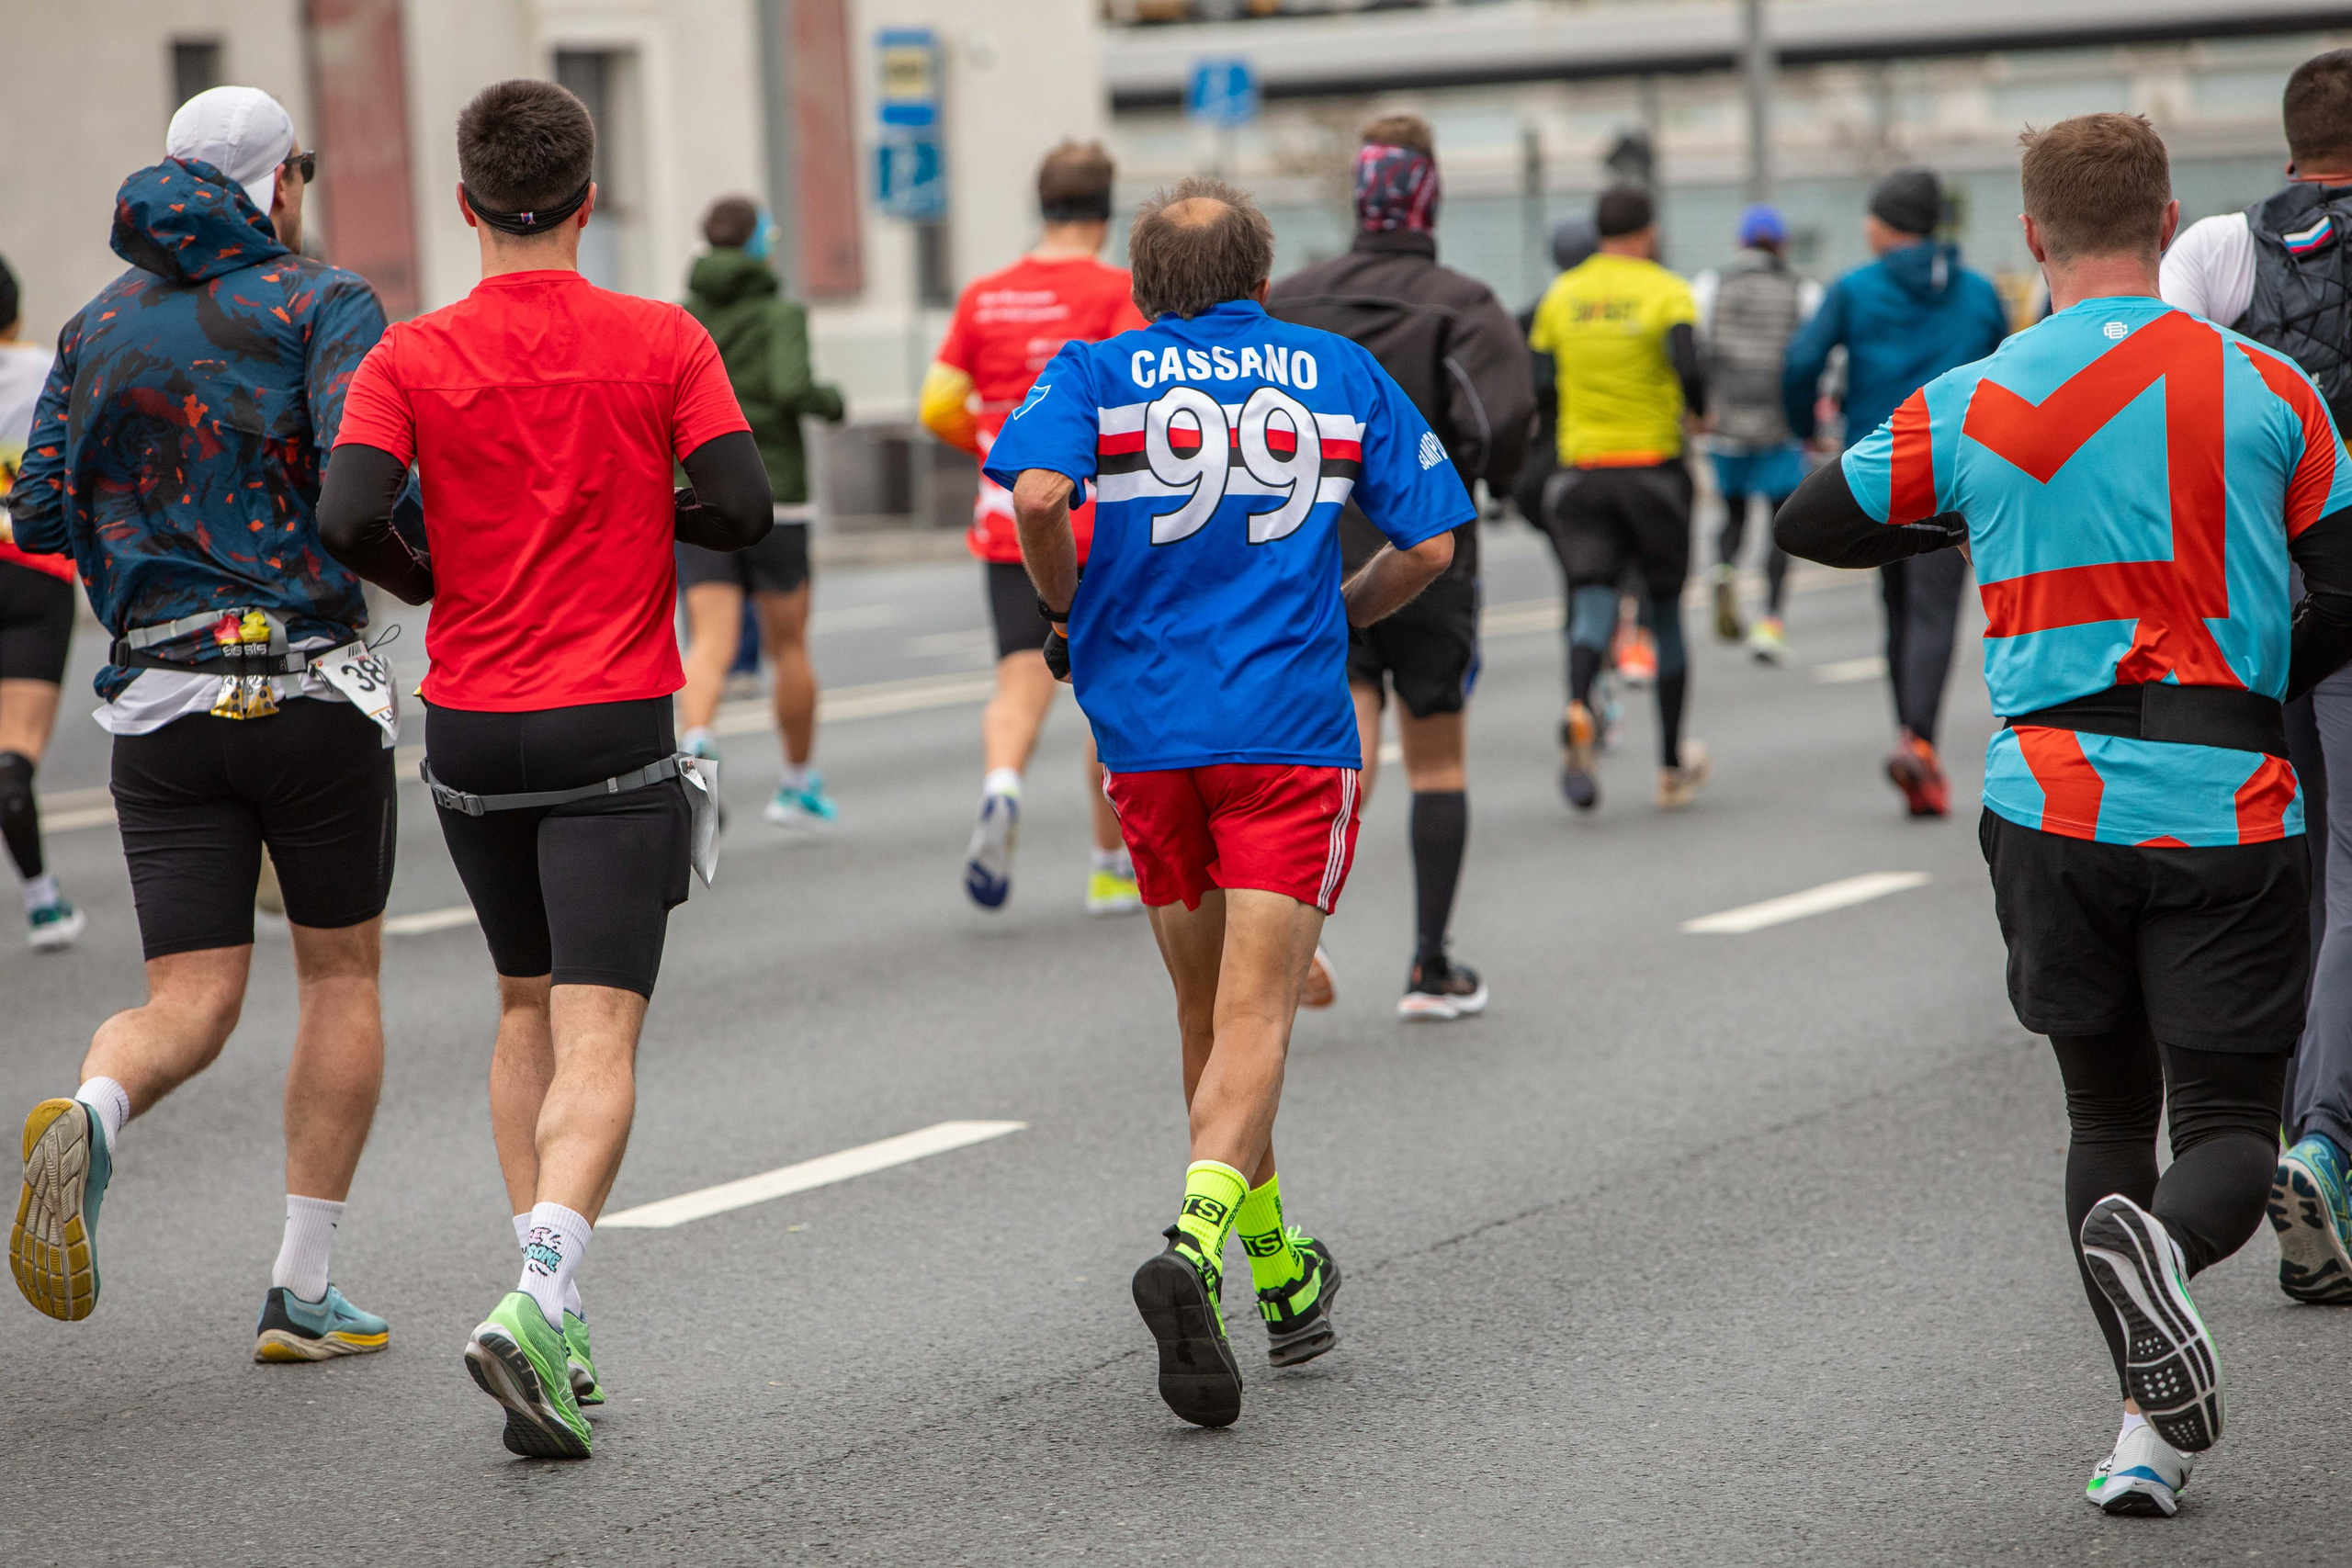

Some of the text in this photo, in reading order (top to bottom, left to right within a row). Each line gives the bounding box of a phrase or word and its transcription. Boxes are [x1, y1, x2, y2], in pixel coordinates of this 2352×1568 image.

[1131, 344, 1317, 390] CASSANO
[1144, 385, 1322, 547] 99
[1240, 1233, 1281, 1257] TS
